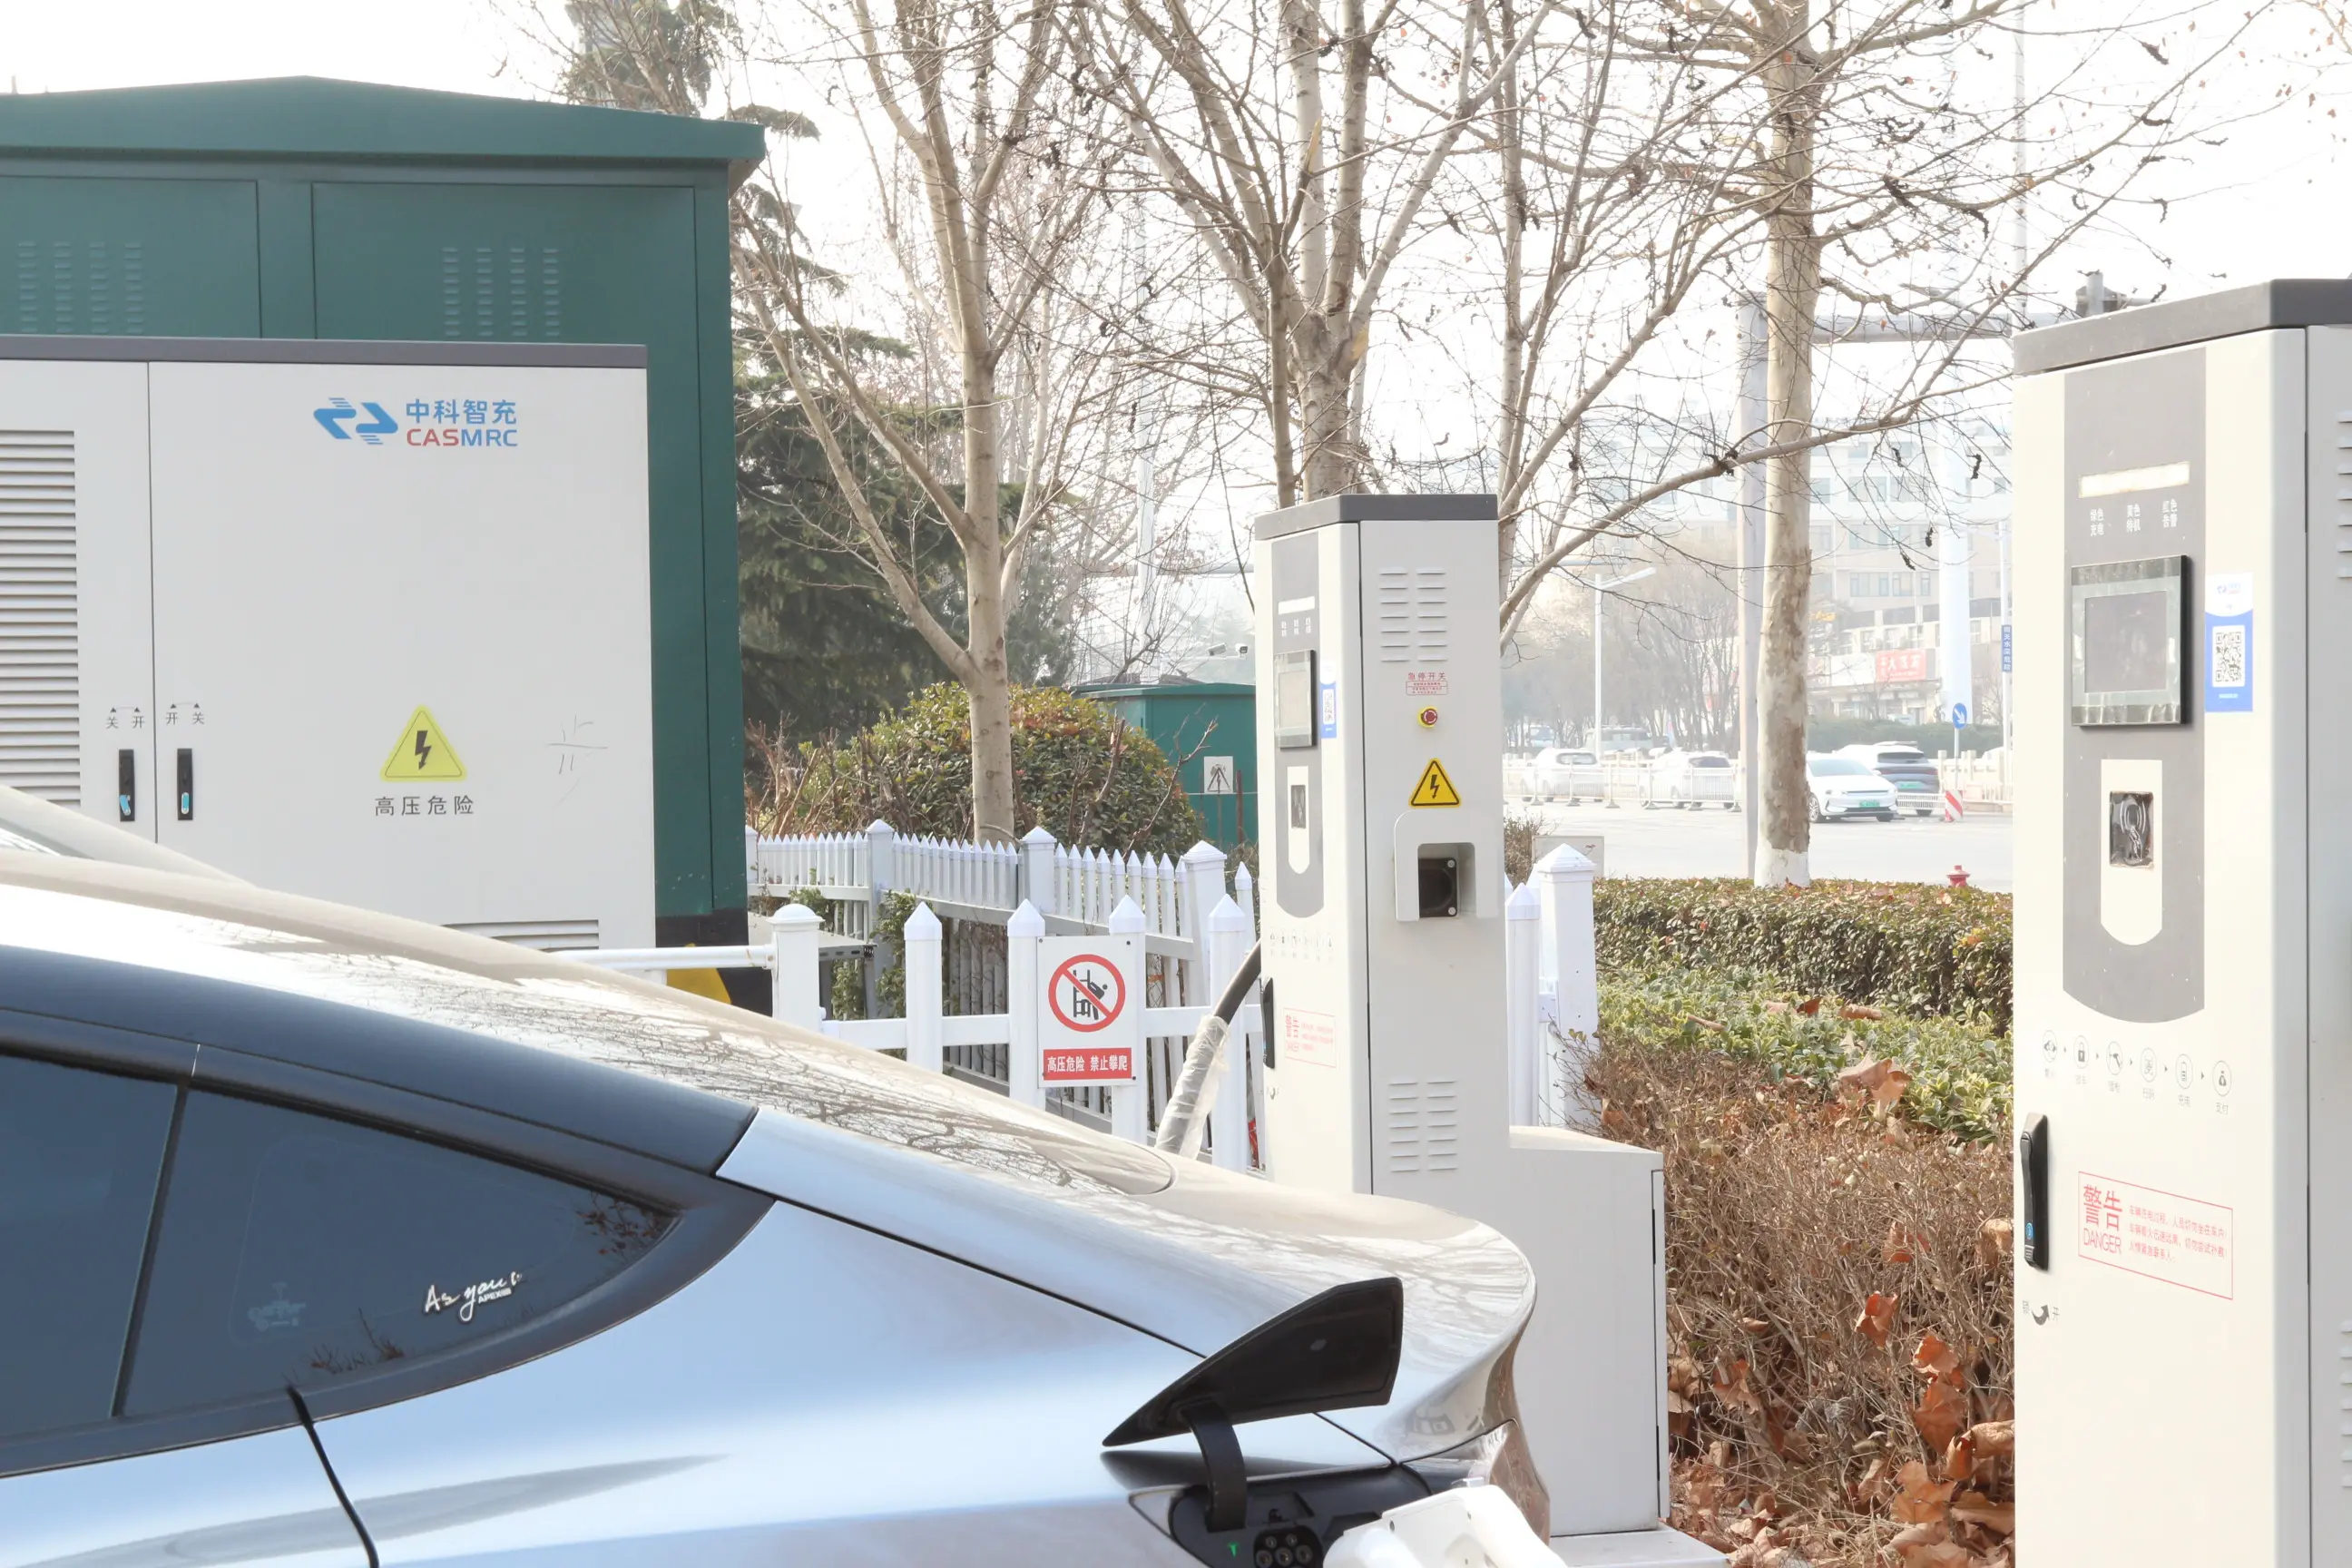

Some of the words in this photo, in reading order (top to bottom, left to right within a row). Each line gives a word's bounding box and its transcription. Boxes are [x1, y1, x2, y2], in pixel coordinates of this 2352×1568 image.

[406, 398, 516, 424] 中科智充
[407, 428, 518, 446] CASMRC
[106, 716, 118, 730] 关
[132, 716, 144, 729] 开
[166, 712, 178, 725] 开
[192, 712, 204, 725] 关
[375, 795, 474, 816] 高压危险
[1047, 1055, 1085, 1073] 高压危险
[1090, 1054, 1128, 1072] 禁止攀爬
[2083, 1184, 2122, 1231] 警告
[2083, 1228, 2122, 1255] DANGER
[425, 1284, 461, 1313] As
[459, 1278, 507, 1322] you
